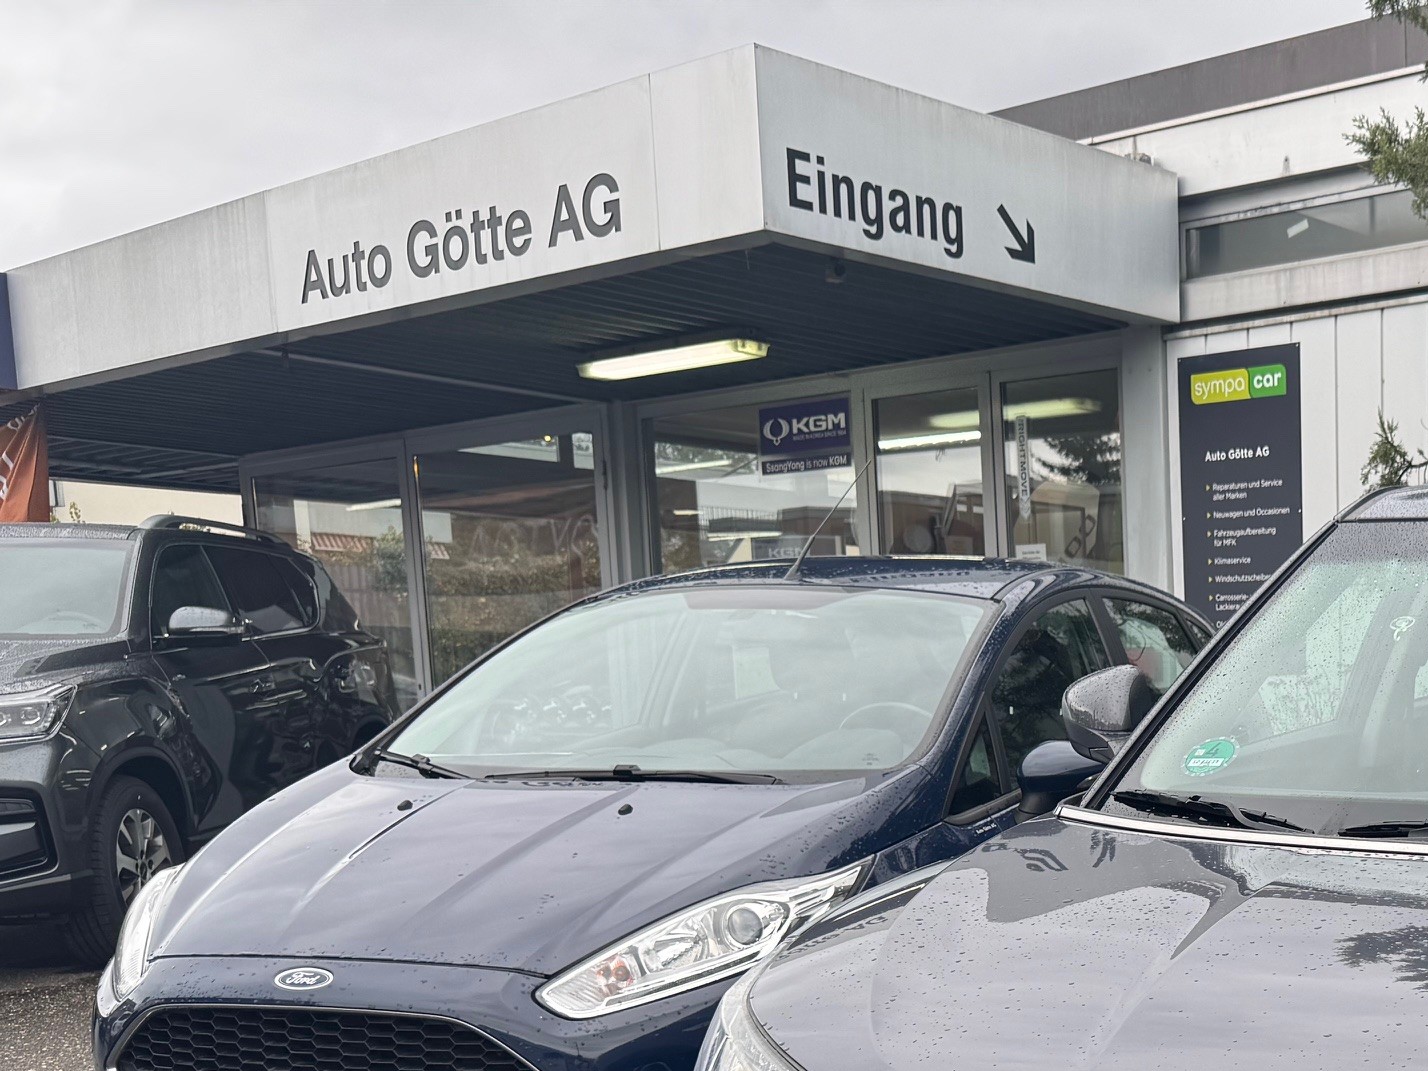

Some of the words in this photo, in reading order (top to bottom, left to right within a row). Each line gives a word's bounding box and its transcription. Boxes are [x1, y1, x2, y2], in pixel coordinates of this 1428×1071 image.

[786, 147, 964, 259] Eingang
[301, 240, 392, 304] Auto
[406, 205, 532, 279] Götte
[547, 172, 622, 248] AG
[1194, 377, 1245, 400] sympa
[1253, 372, 1282, 389] car
[792, 412, 846, 434] KGM
[1205, 451, 1226, 462] Auto
[1228, 447, 1253, 460] Götte
[1255, 445, 1270, 457] AG
[766, 461, 805, 473] SsangYong
[806, 460, 812, 469] is
[813, 459, 828, 468] now
[829, 455, 847, 466] KGM
[1212, 482, 1248, 492] Reparaturen
[1248, 480, 1260, 489] und
[1261, 479, 1283, 488] Service
[1225, 491, 1248, 500] Marken
[1213, 510, 1244, 519] Neuwagen
[1244, 508, 1256, 517] und
[1256, 506, 1290, 516] Occasionen
[1214, 556, 1252, 565] Klimaservice
[286, 971, 321, 985] Ford
